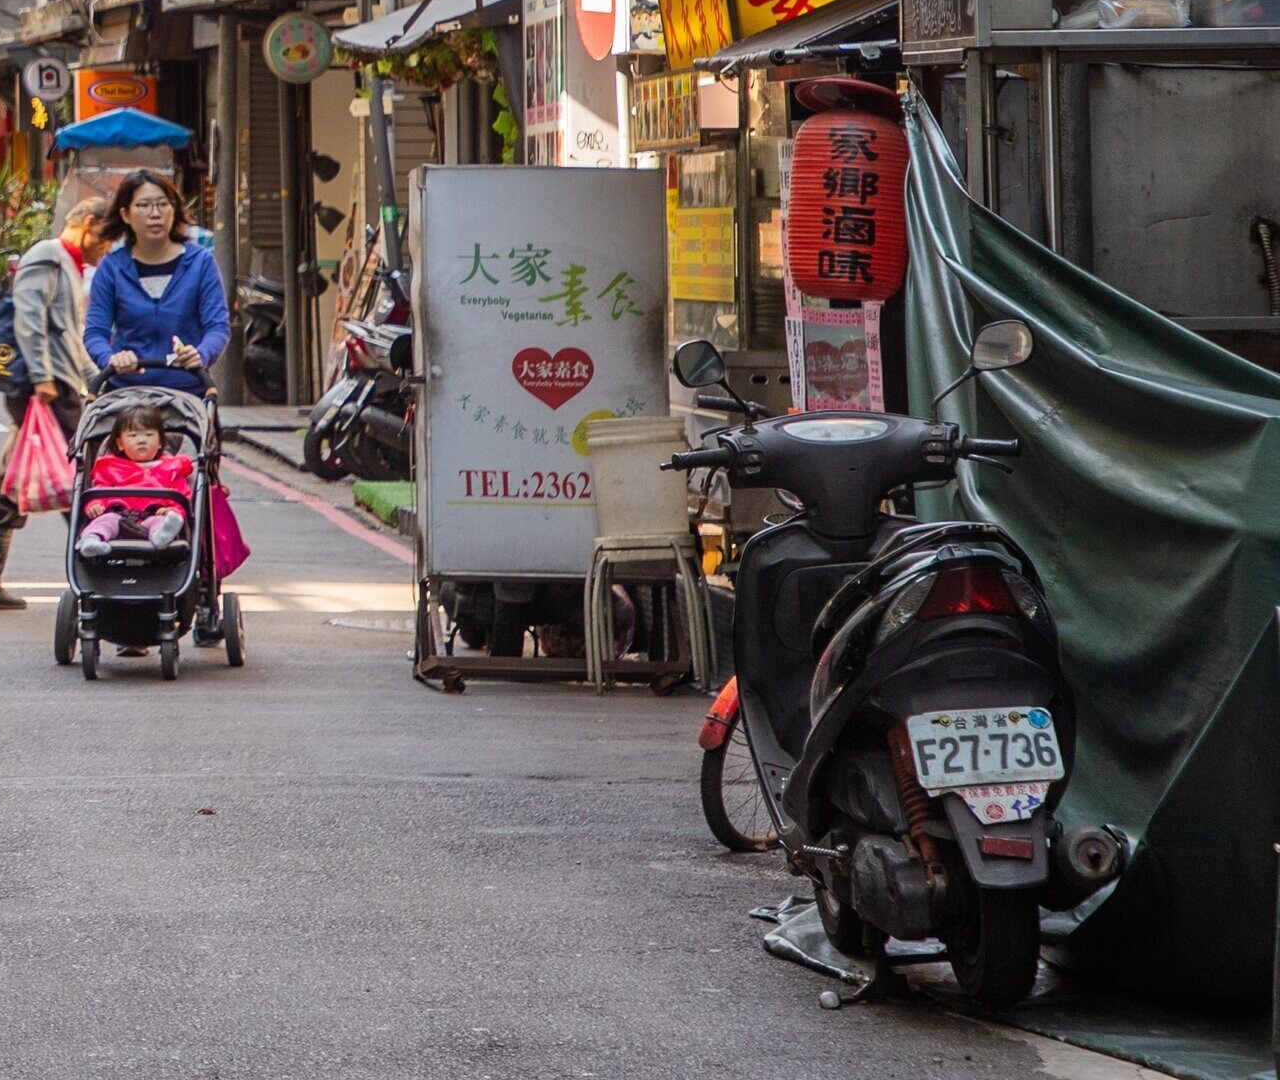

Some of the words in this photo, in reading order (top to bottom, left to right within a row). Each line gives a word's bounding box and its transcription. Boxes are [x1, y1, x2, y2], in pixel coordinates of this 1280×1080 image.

[817, 124, 880, 285] 家鄉滷味
[501, 310, 554, 321] Vegetarian
[952, 714, 1009, 731] 台灣省
